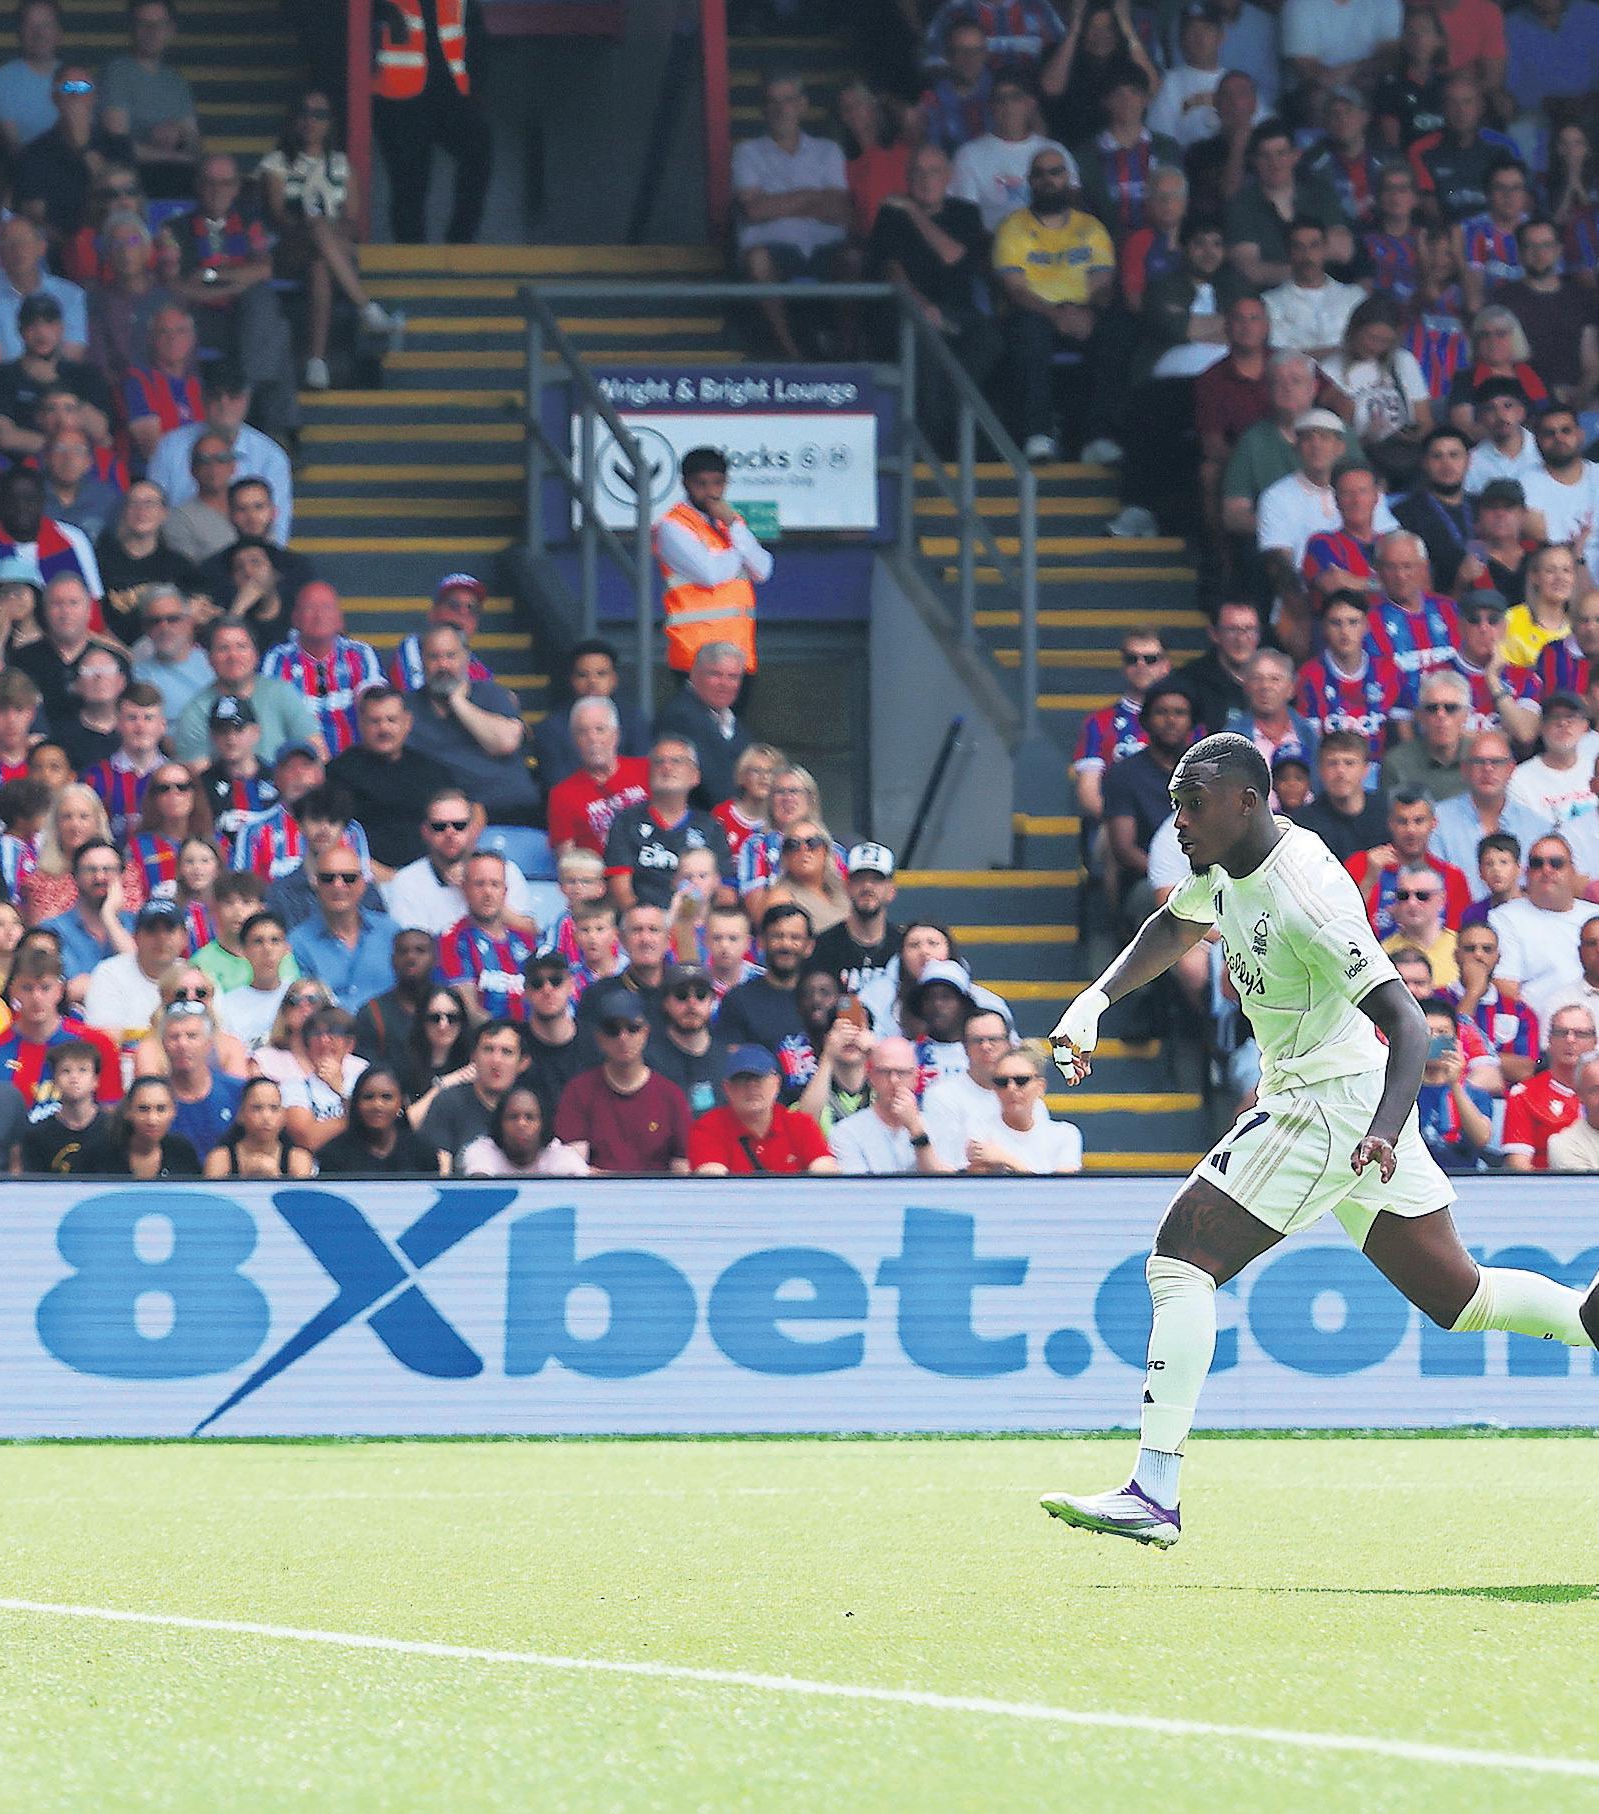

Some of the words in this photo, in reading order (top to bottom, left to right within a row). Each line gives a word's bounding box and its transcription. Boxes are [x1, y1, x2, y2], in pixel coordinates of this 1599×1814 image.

[674, 377, 696, 403] &
[699, 376, 771, 407] Bright
[774, 377, 859, 408] Lounge
[719, 442, 791, 469] locks
